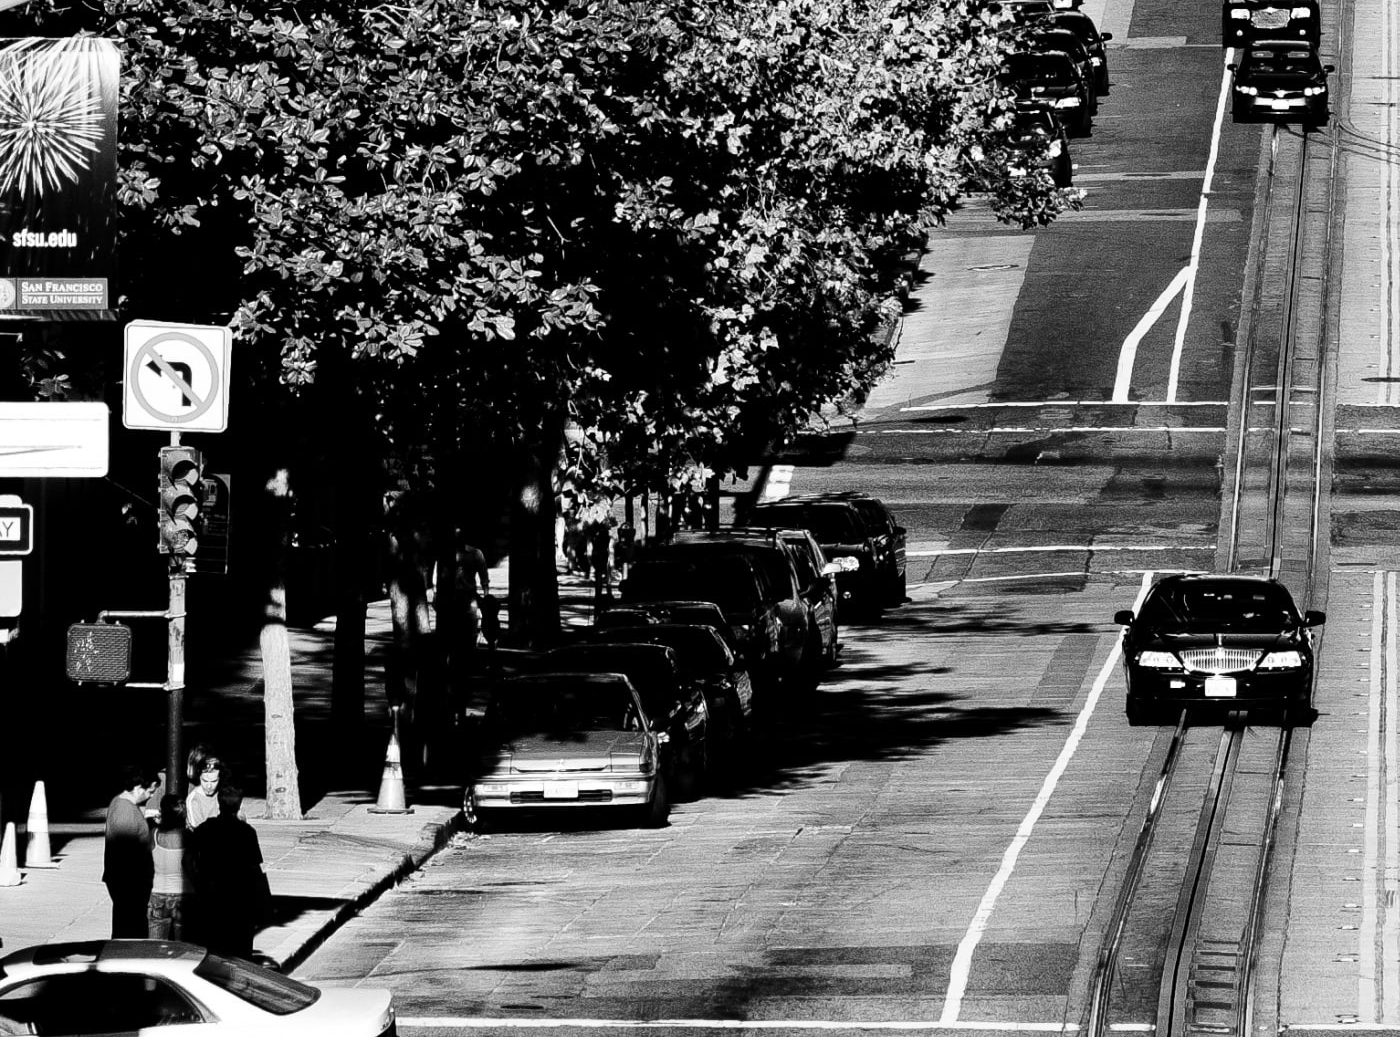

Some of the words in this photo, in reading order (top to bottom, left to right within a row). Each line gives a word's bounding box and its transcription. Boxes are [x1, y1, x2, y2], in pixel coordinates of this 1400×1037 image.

[12, 228, 78, 248] sfsu.edu
[21, 281, 43, 293] SAN
[45, 281, 104, 293] FRANCISCO
[21, 294, 49, 305] STATE
[50, 294, 104, 305] UNIVERSITY
[0, 521, 14, 538] Y
